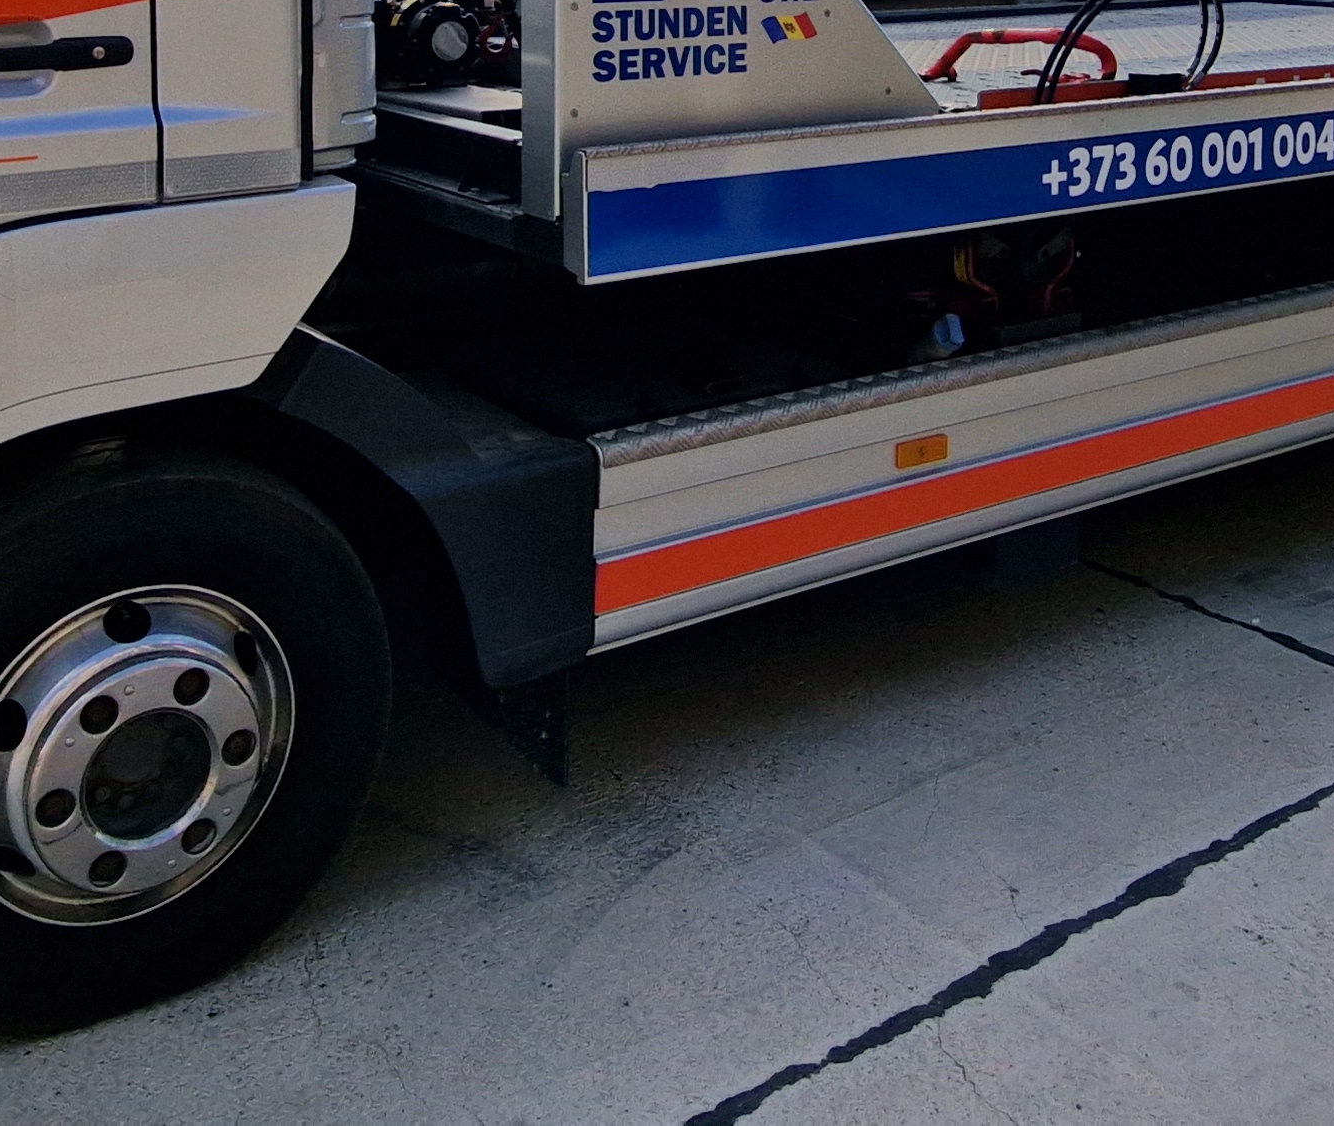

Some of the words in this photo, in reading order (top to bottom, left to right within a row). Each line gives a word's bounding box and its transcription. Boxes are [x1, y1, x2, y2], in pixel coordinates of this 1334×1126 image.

[591, 5, 748, 43] STUNDEN
[591, 42, 748, 82] SERVICE
[1041, 141, 1137, 197] +373
[1144, 132, 1194, 183] 60
[1200, 126, 1265, 177] 001
